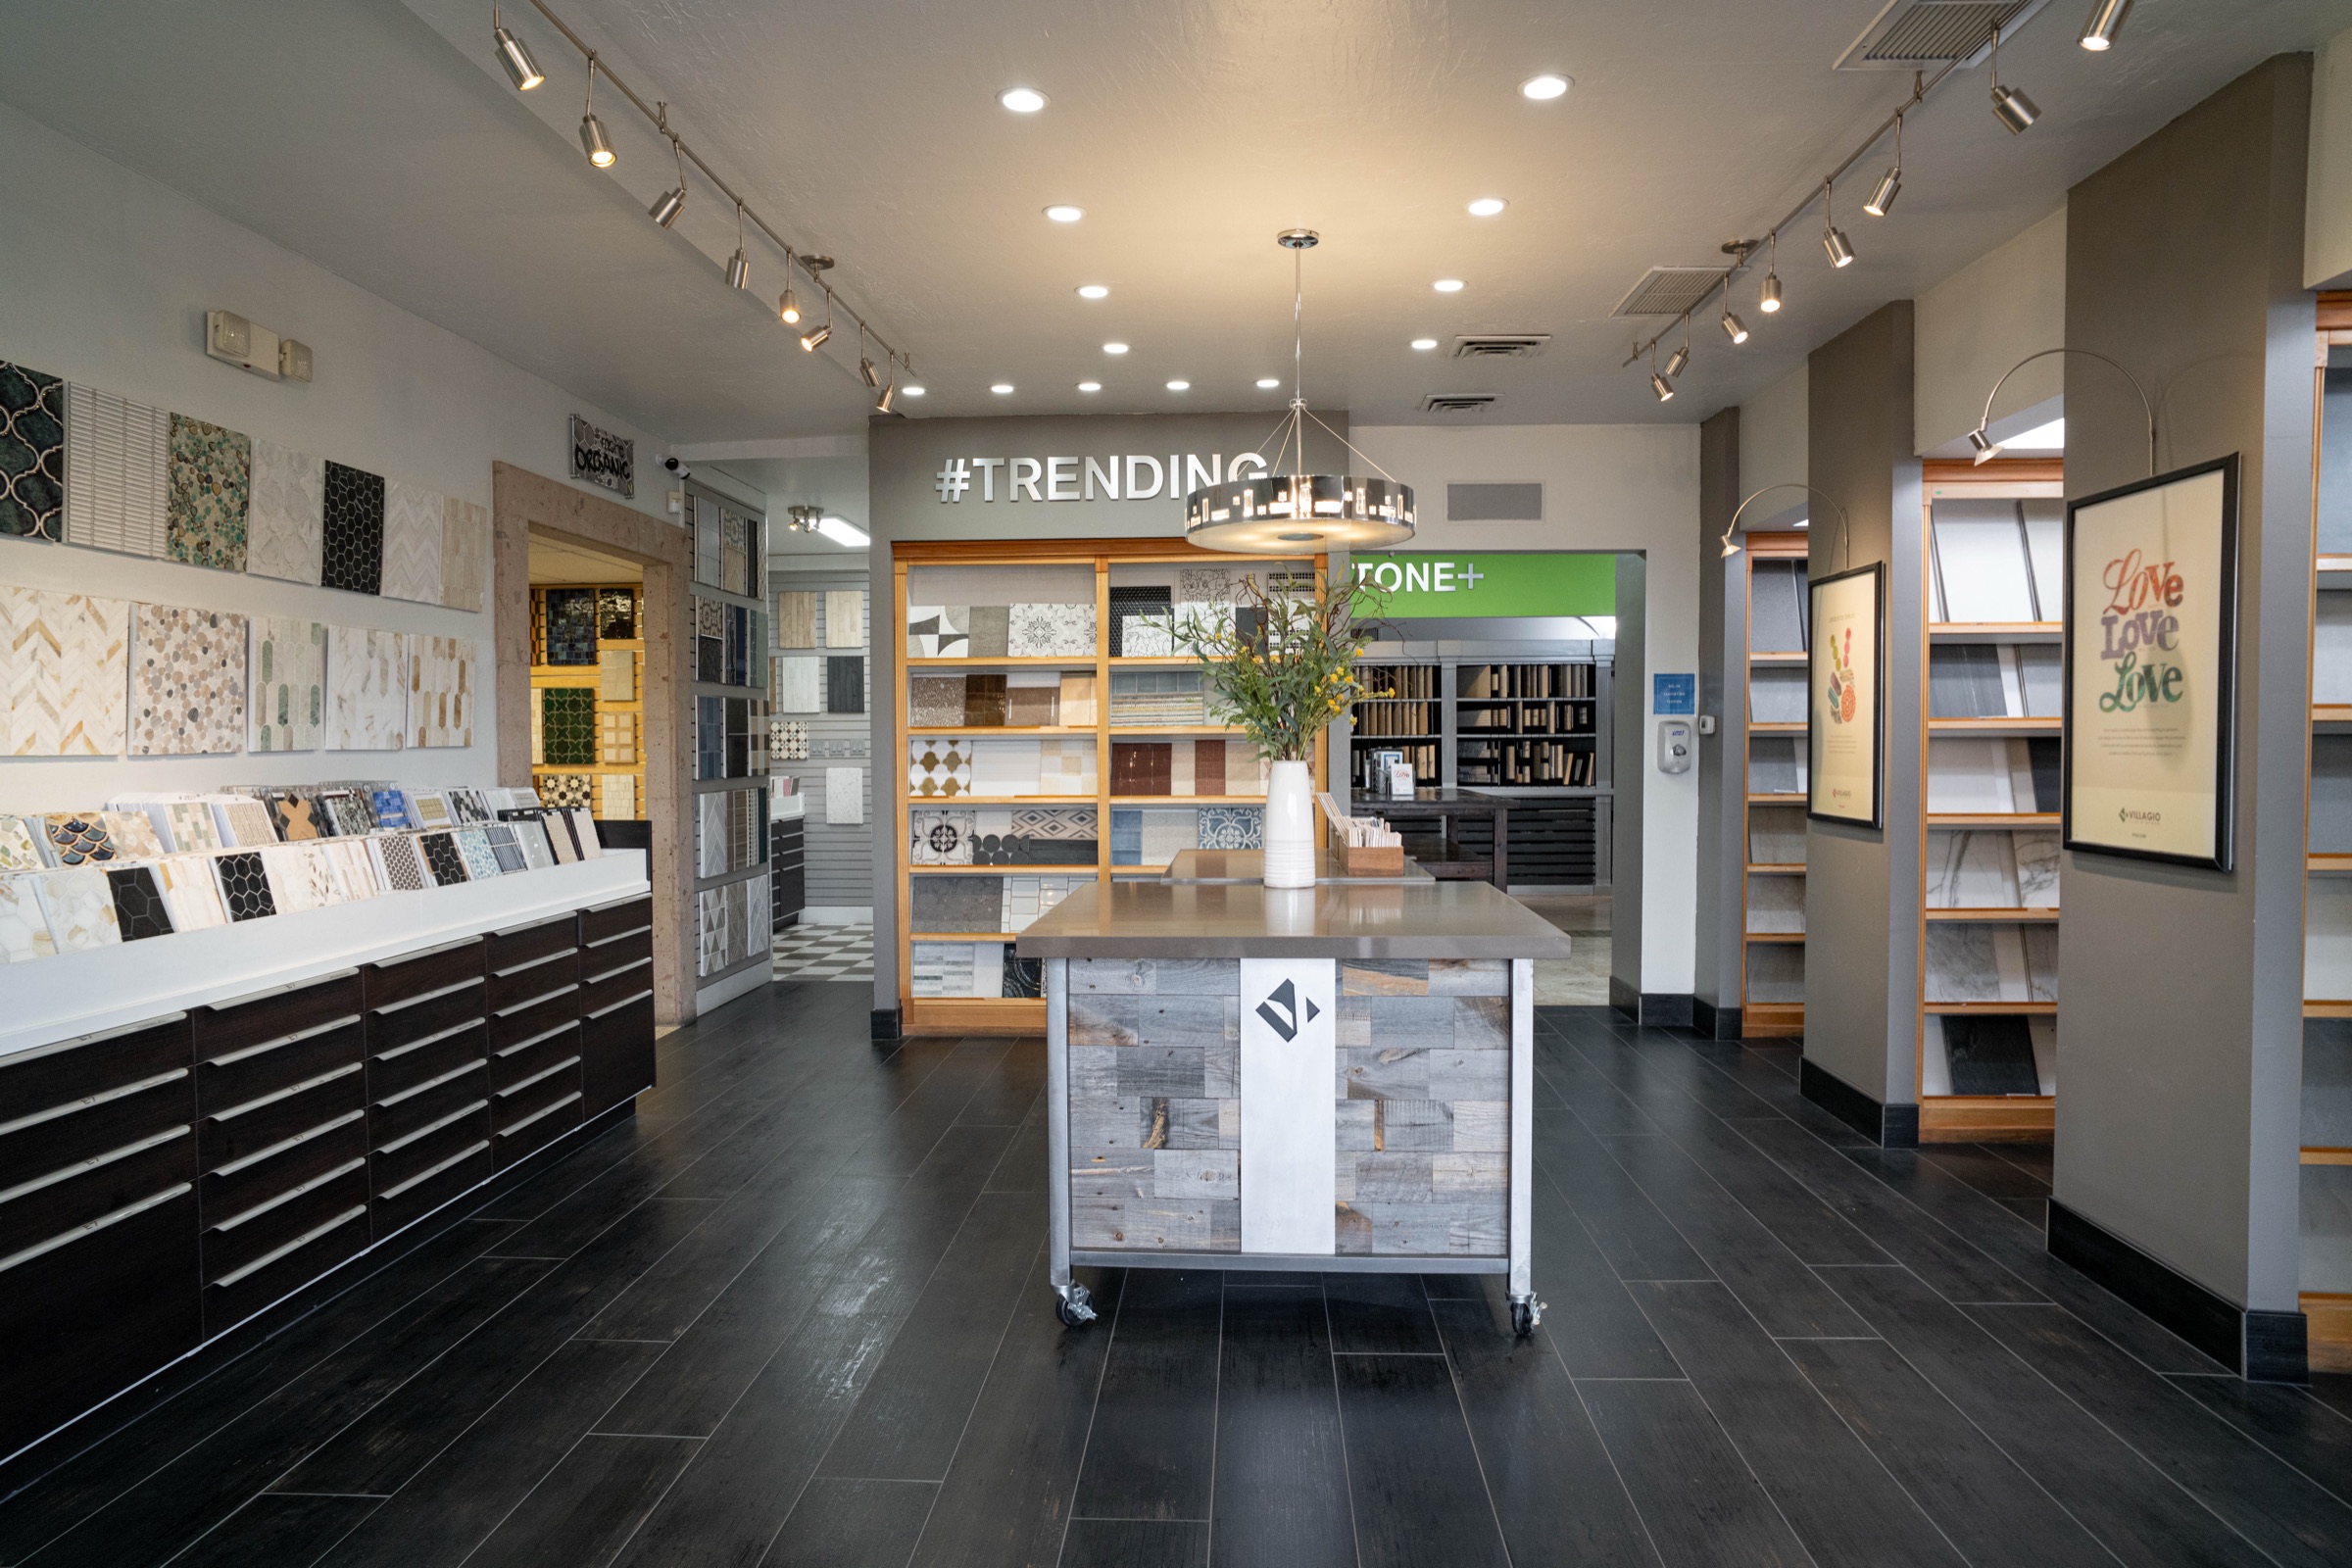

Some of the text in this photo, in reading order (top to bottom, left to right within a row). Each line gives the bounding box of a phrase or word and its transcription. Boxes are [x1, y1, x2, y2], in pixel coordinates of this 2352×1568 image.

[575, 444, 630, 479] ORGANIC
[601, 436, 624, 458] more
[935, 452, 1268, 504] #TRENDING
[2102, 548, 2184, 615] Love
[2100, 610, 2180, 661] Love
[2099, 651, 2184, 713] Love
[2129, 809, 2162, 822] VILLAGIO
